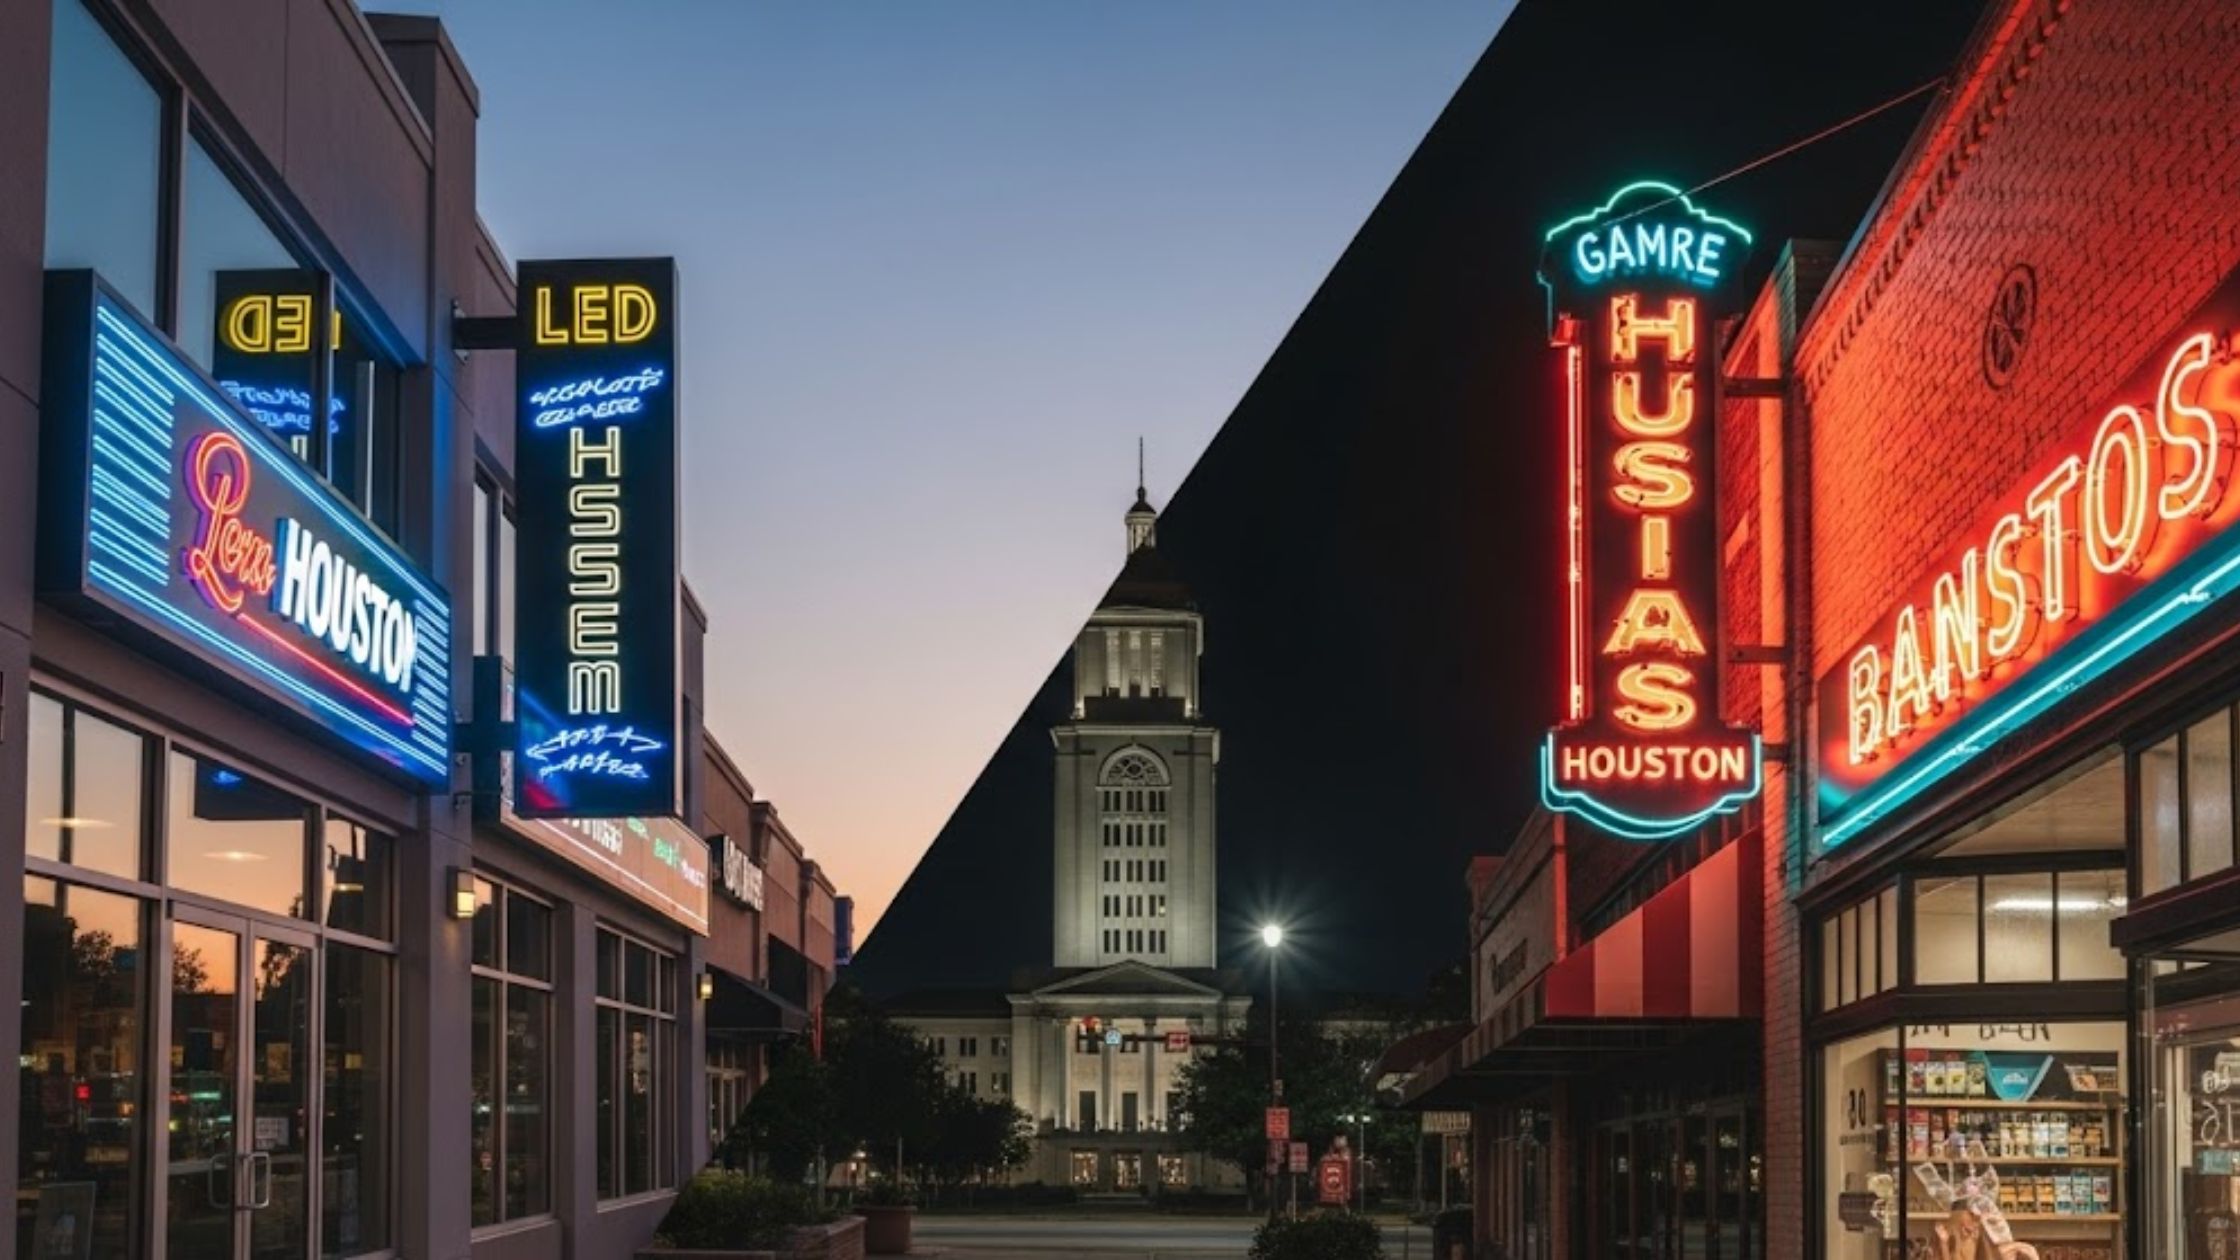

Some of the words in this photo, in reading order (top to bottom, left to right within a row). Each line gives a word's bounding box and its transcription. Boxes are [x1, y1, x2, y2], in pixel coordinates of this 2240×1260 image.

[1575, 223, 1727, 279] GAMRE
[535, 285, 657, 345] LED
[1602, 295, 1707, 731] HUSIAS
[1848, 332, 2220, 766] BANSTOS
[280, 517, 416, 693] HOUSTON
[1562, 745, 1746, 782] HOUSTON
